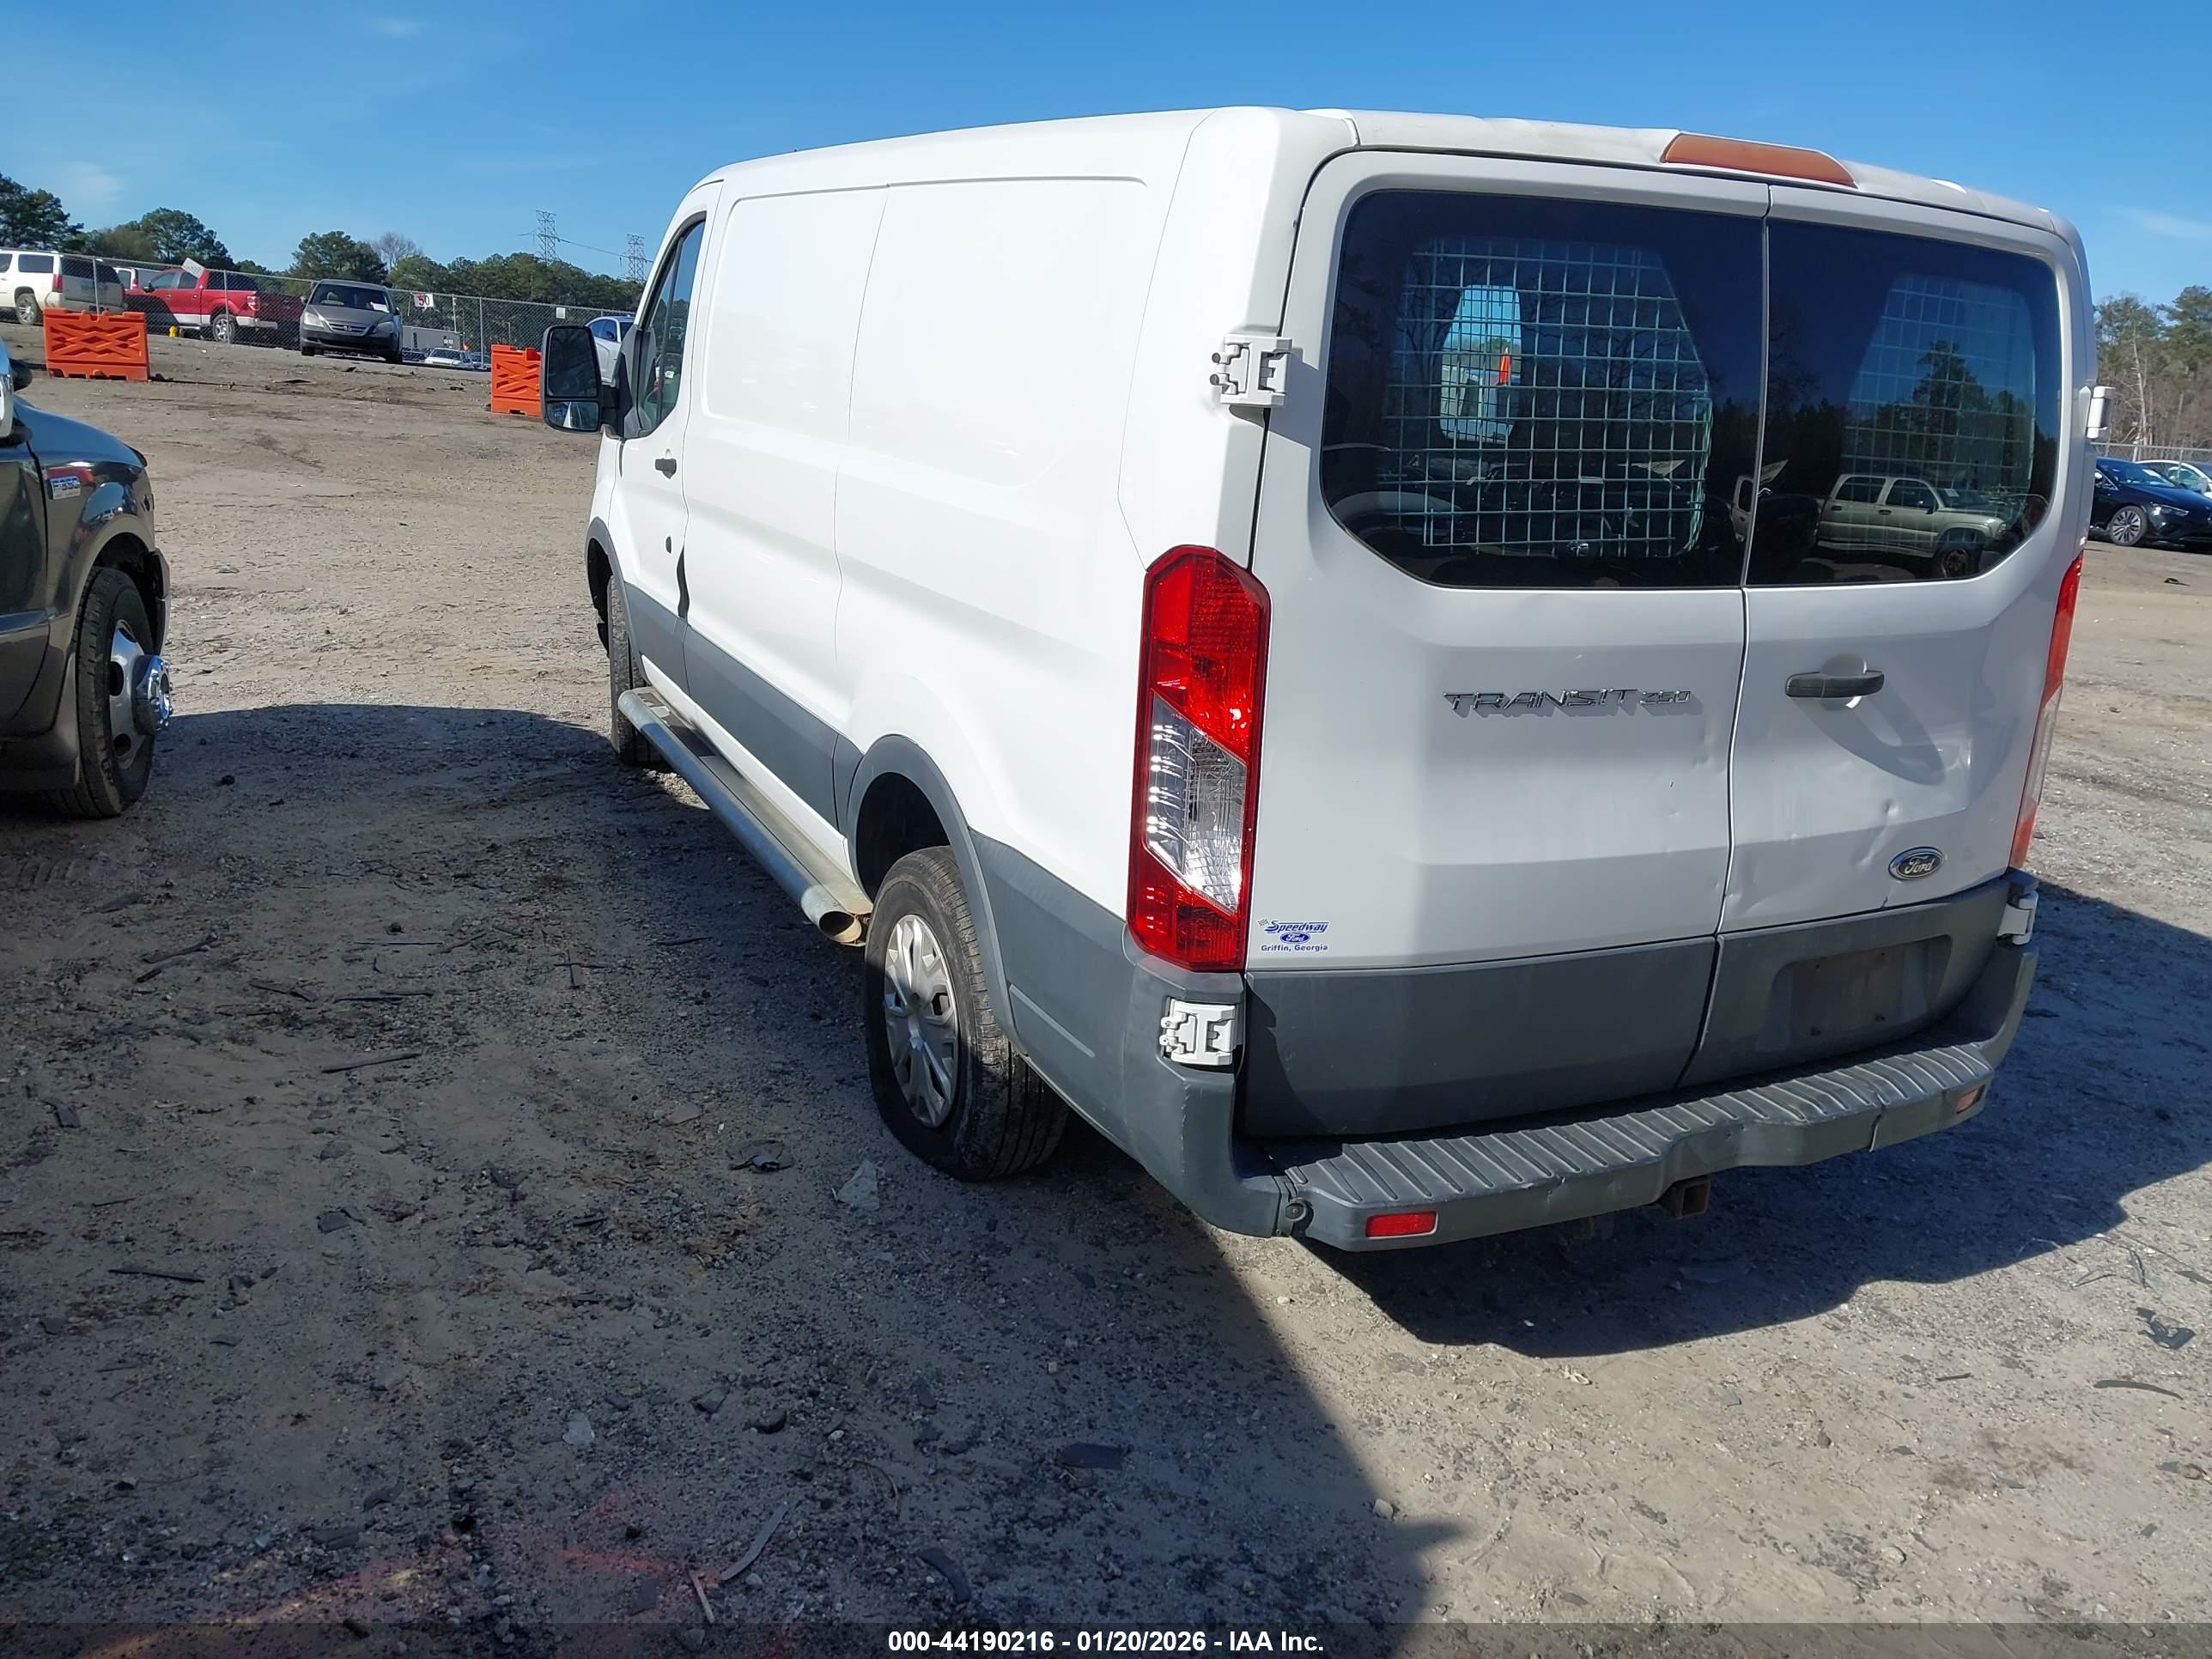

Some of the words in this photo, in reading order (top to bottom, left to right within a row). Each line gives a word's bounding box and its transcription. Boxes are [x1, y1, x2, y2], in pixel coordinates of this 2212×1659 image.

[1443, 688, 1638, 710] TRANSIT
[1639, 690, 1692, 705] 250
[1904, 855, 1936, 875] Ford
[1264, 920, 1329, 934] Speedway
